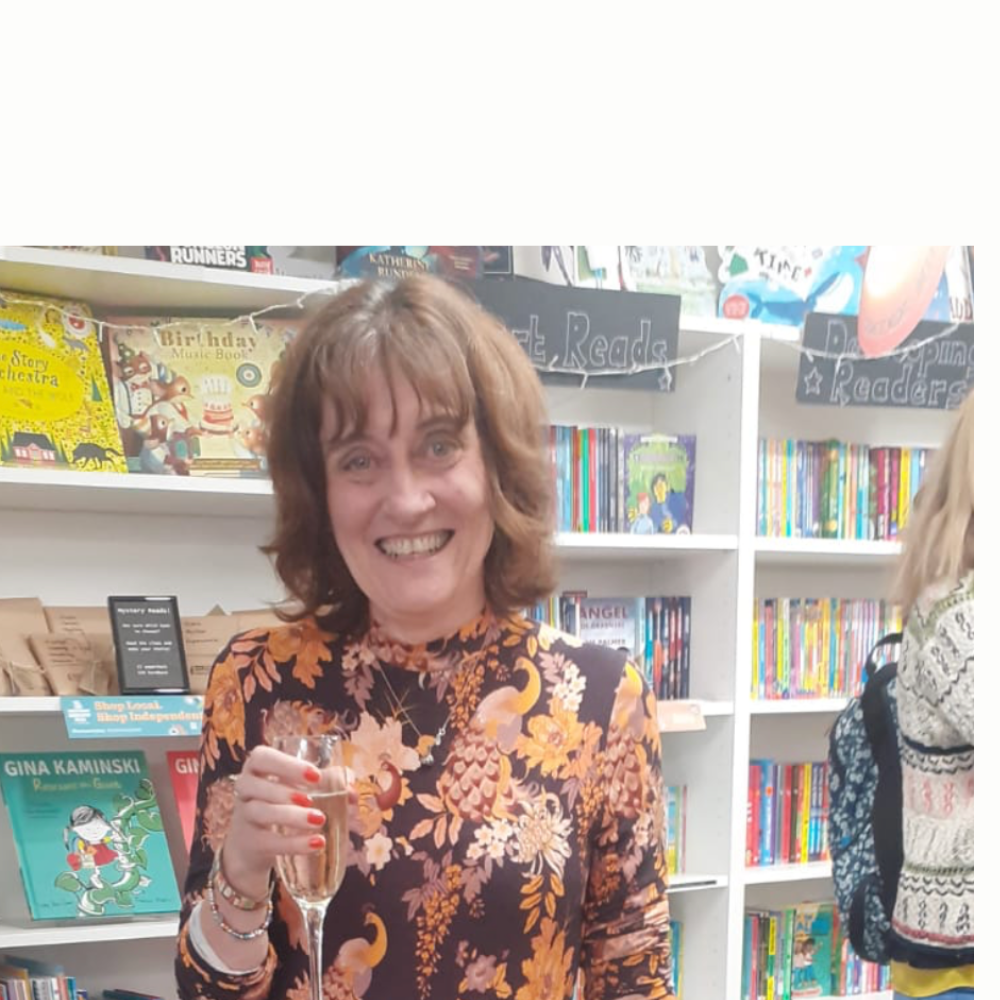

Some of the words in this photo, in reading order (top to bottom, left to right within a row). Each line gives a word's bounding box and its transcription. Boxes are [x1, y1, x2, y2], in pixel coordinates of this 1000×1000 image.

[170, 247, 247, 268] RUNNERS
[563, 311, 668, 369] Reads
[11, 350, 49, 373] Story
[829, 358, 968, 409] Readers
[94, 701, 124, 712] Shop
[97, 712, 127, 724] Shop
[4, 759, 51, 776] GINA
[53, 758, 141, 775] KAMINSKI
